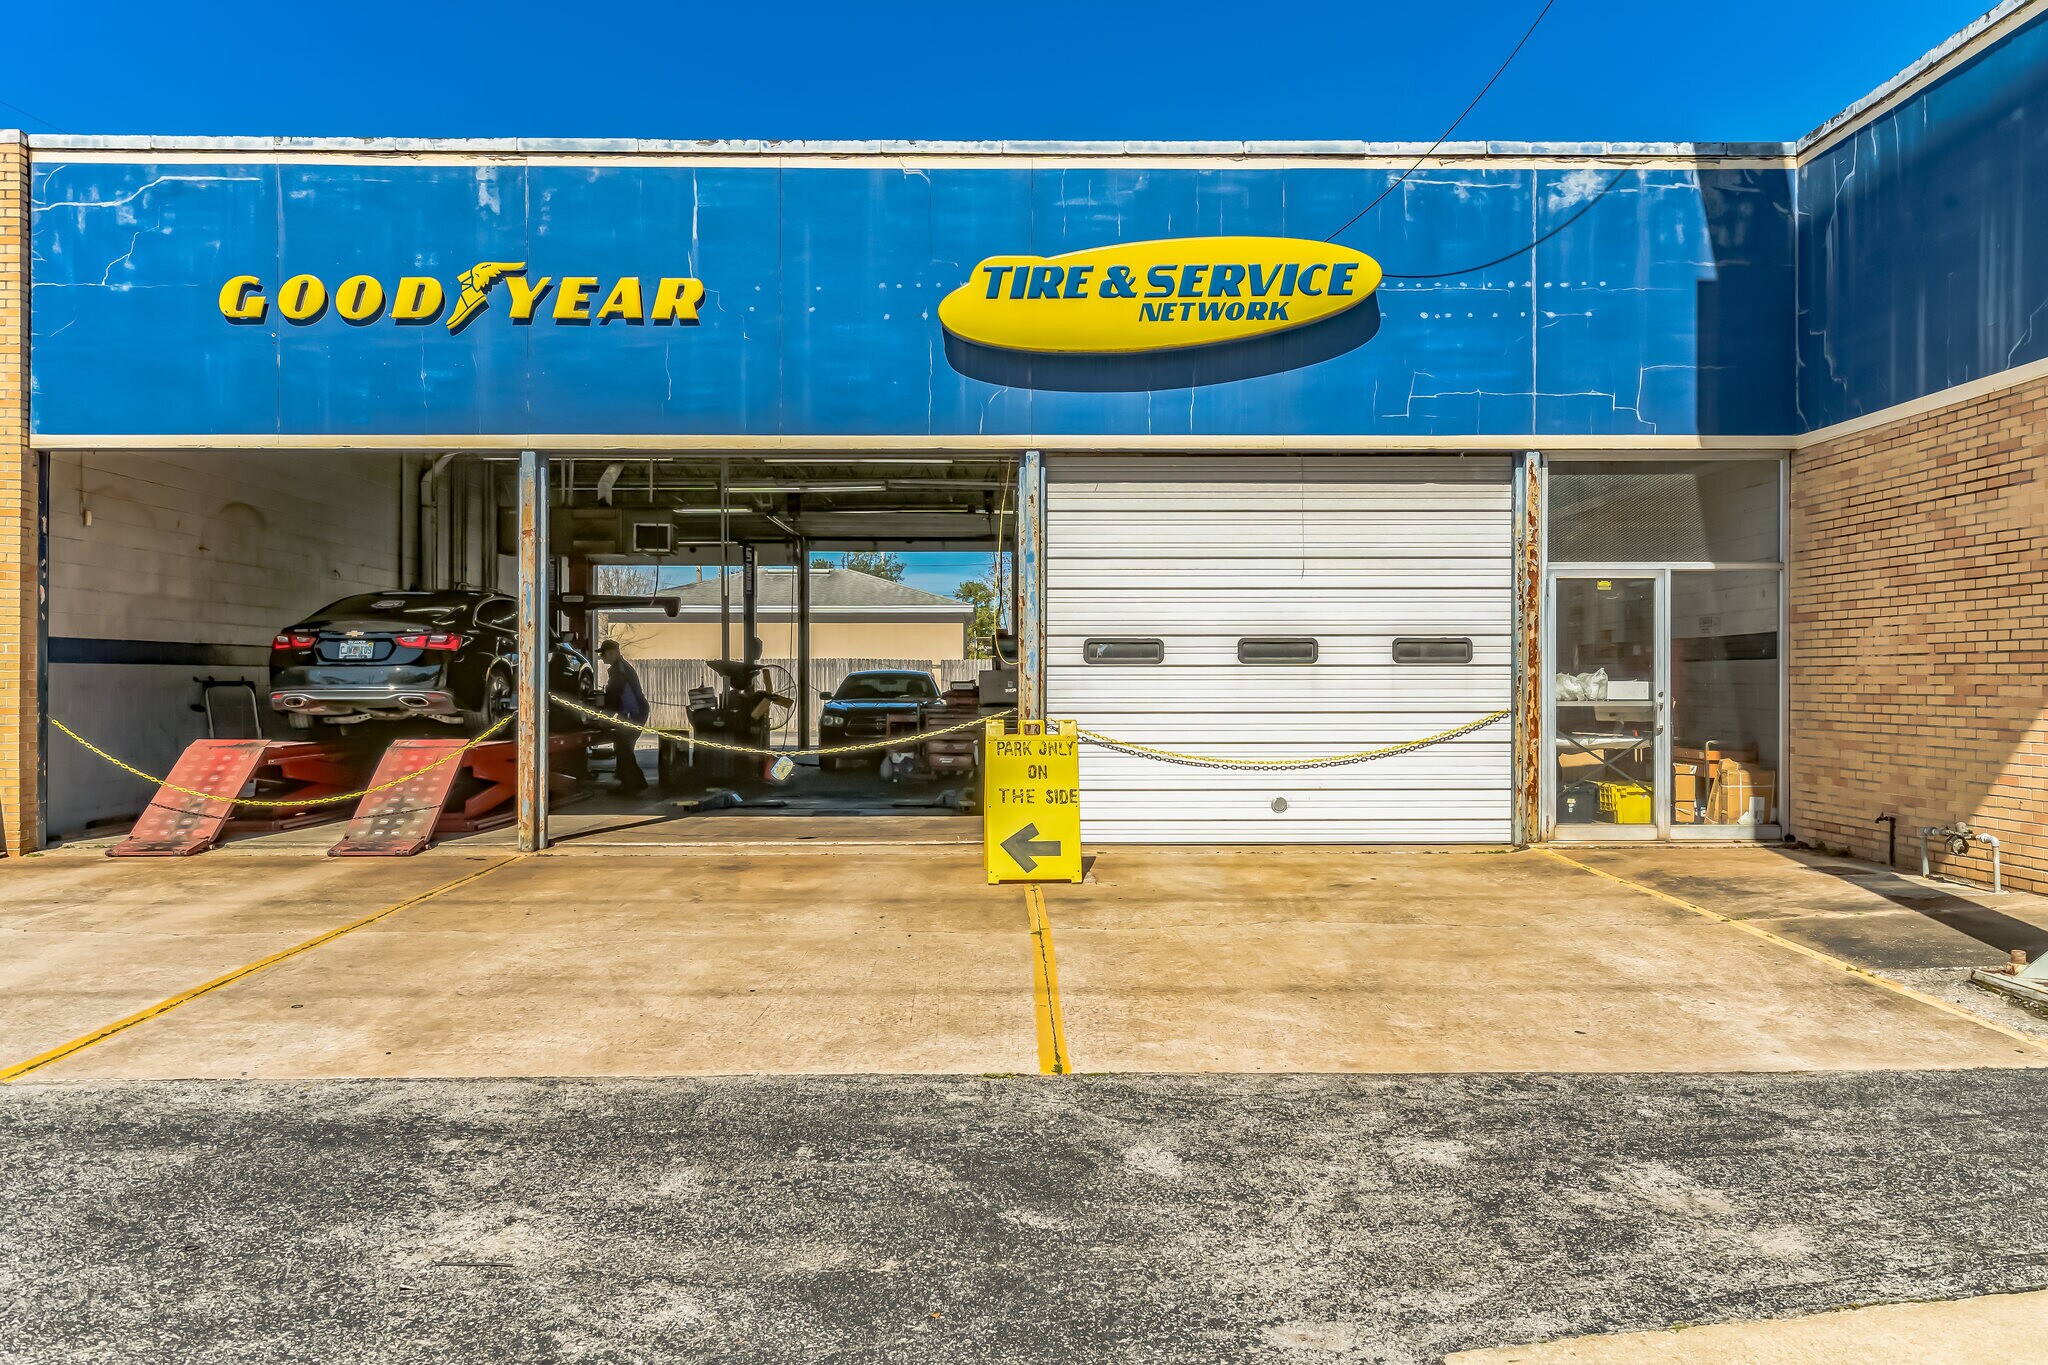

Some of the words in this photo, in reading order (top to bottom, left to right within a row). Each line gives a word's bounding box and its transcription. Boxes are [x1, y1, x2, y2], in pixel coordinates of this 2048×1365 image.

[983, 264, 1094, 300] TIRE
[1099, 264, 1141, 299] &
[1144, 262, 1360, 298] SERVICE
[1138, 301, 1291, 323] NETWORK
[996, 741, 1033, 757] PARK
[1038, 741, 1075, 757] ONLY
[1027, 764, 1048, 780] ON
[998, 788, 1036, 804] THE
[1045, 788, 1078, 805] SIDE
